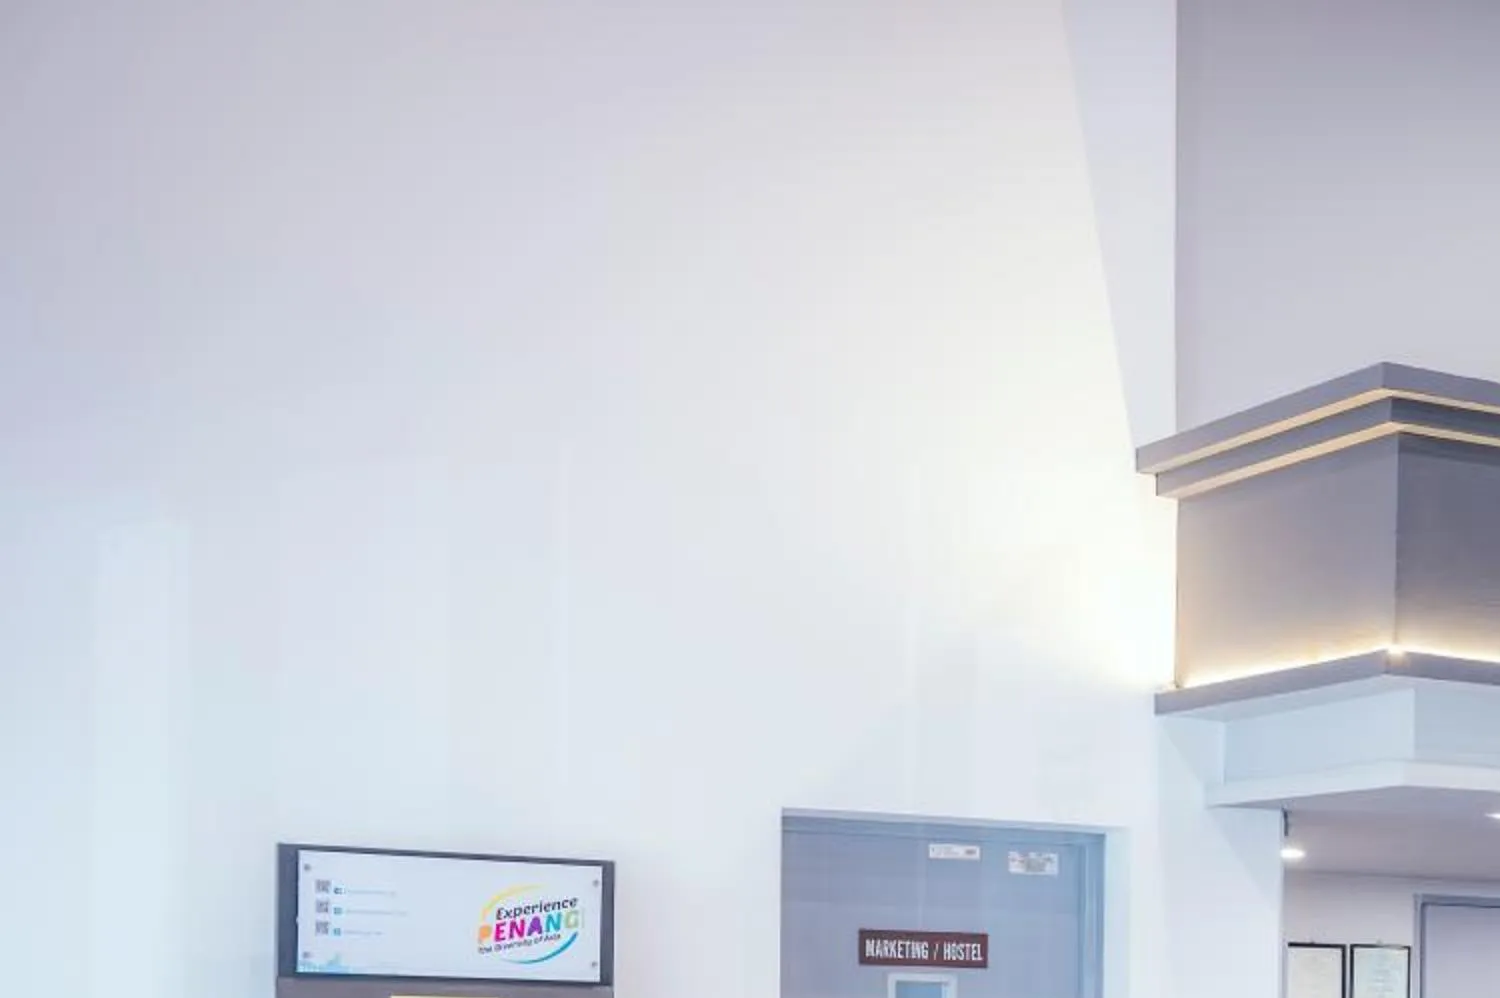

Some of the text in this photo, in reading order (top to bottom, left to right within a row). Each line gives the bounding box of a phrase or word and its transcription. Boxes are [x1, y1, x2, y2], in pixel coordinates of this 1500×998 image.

[496, 897, 579, 920] Experience
[478, 909, 580, 943] PENANG
[865, 938, 928, 959] MARKETING
[943, 941, 984, 961] HOSTEL
